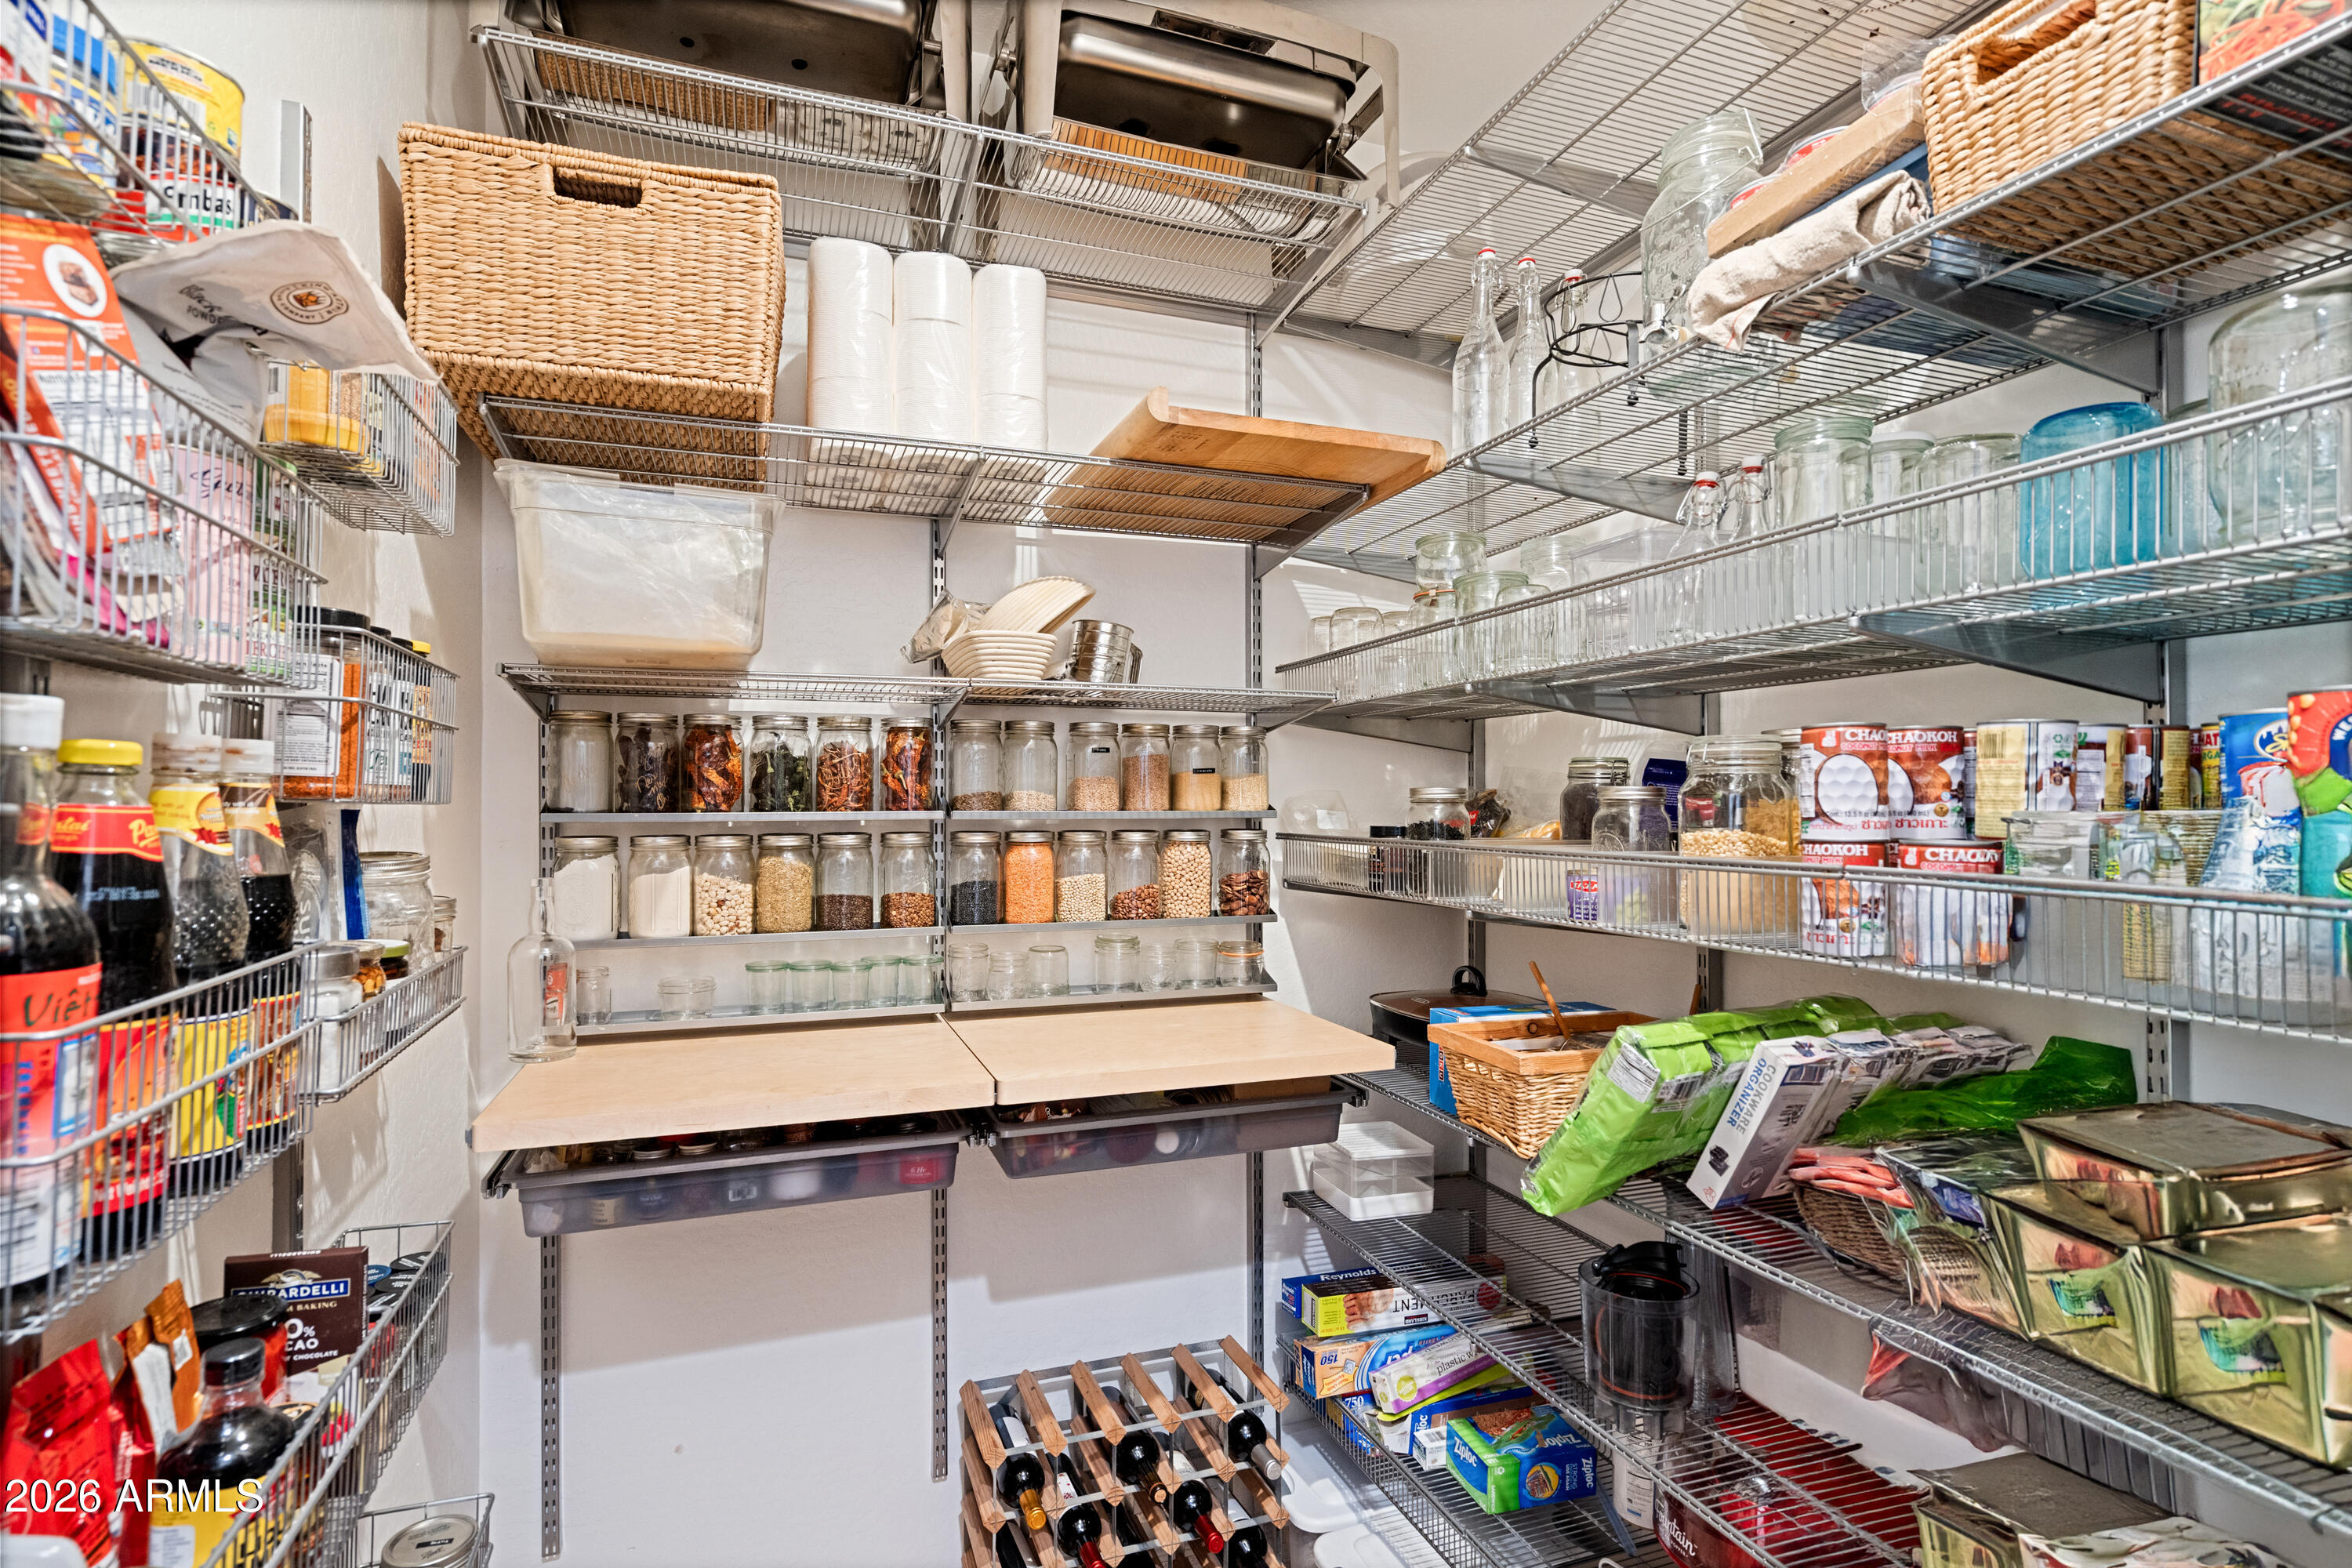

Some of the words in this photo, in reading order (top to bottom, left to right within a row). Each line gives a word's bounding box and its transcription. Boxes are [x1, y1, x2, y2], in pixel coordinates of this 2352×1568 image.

[1726, 1057, 1768, 1128] ORGANIZER
[1735, 1065, 1777, 1135] COOKWARE
[1320, 1269, 1377, 1282] Reynolds
[238, 1283, 346, 1299] RARDELLI
[296, 1301, 338, 1312] BAKING
[285, 1318, 316, 1339] 0%
[285, 1338, 319, 1352] CAO
[292, 1349, 339, 1362] CHOCOLATE
[1320, 1354, 1338, 1366] 150
[1436, 1353, 1466, 1376] plastic
[1345, 1396, 1364, 1409] 750
[1454, 1436, 1478, 1468] Ziploc
[1581, 1456, 1595, 1489] Ziploc
